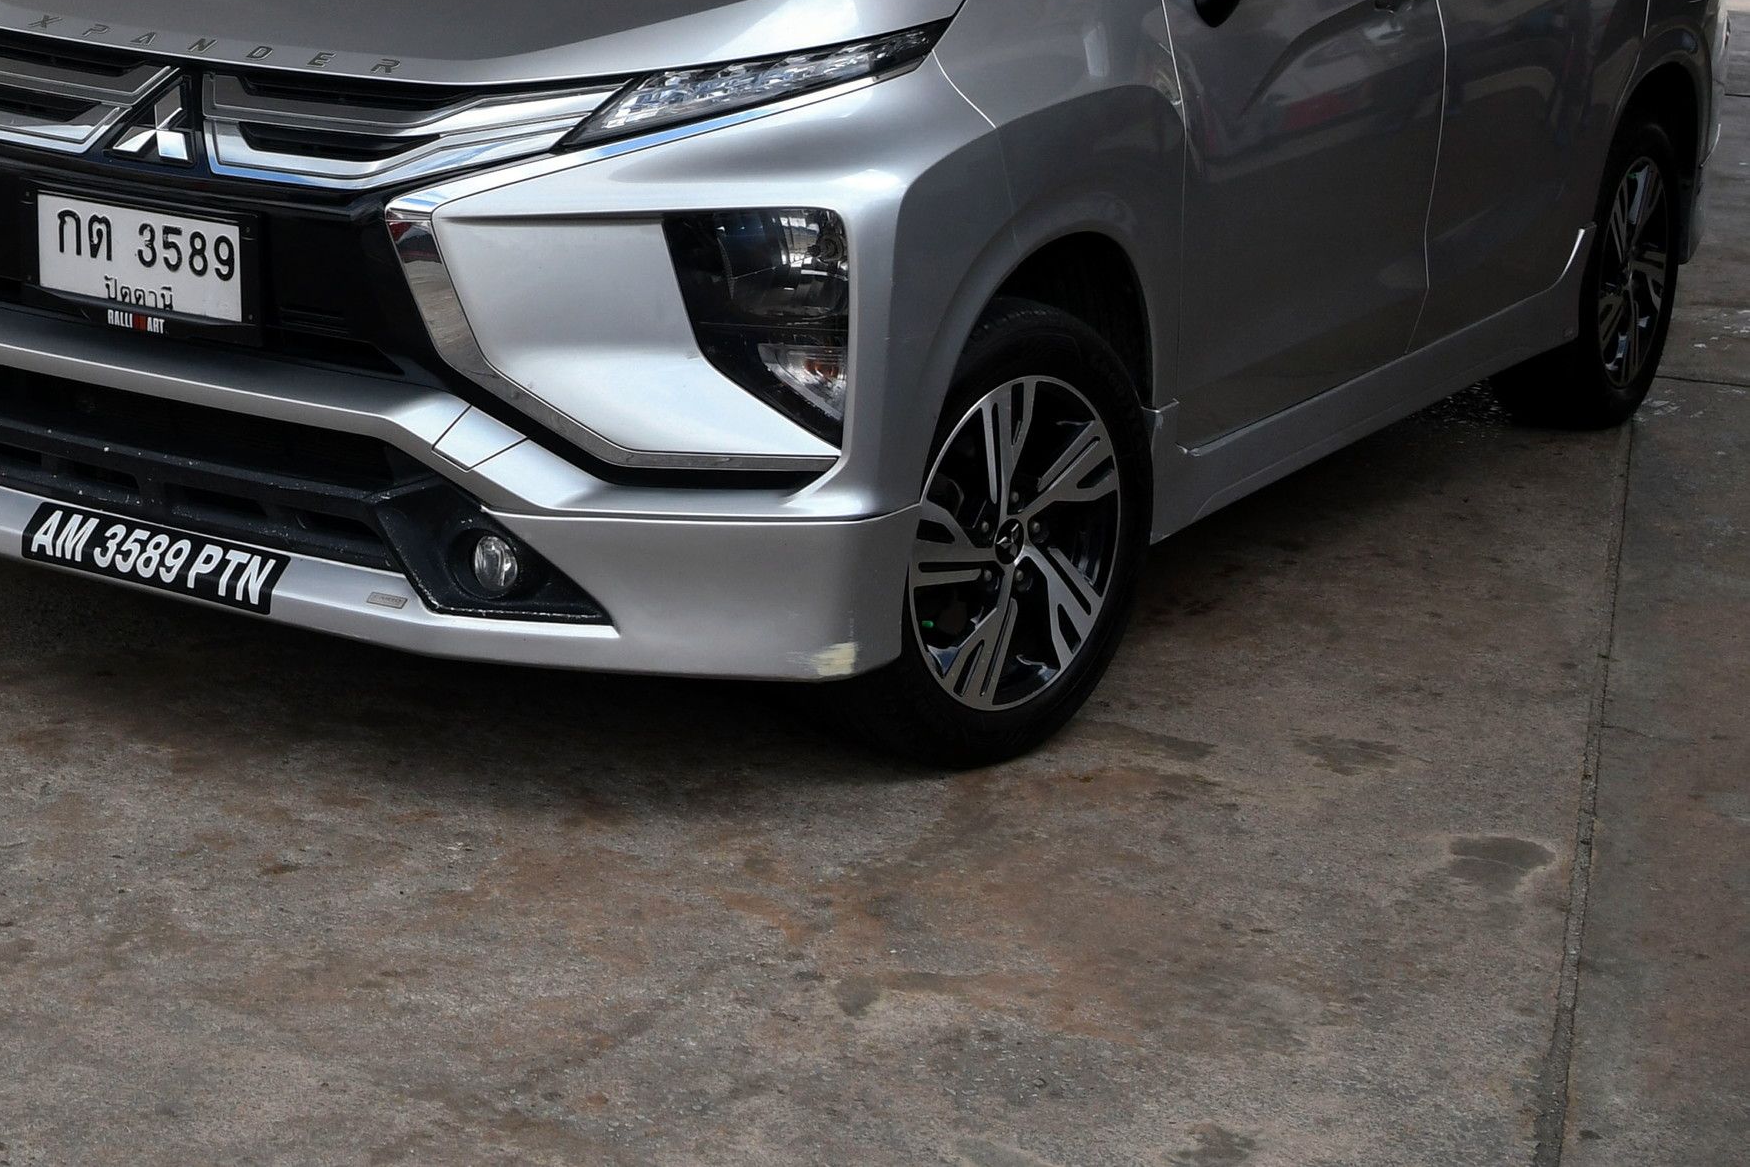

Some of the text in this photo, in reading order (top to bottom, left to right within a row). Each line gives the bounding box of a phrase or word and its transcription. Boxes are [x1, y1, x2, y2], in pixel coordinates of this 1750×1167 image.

[28, 14, 402, 74] XPANDER
[57, 209, 236, 282] กต 3589
[30, 510, 278, 606] AM 3589 PTN
